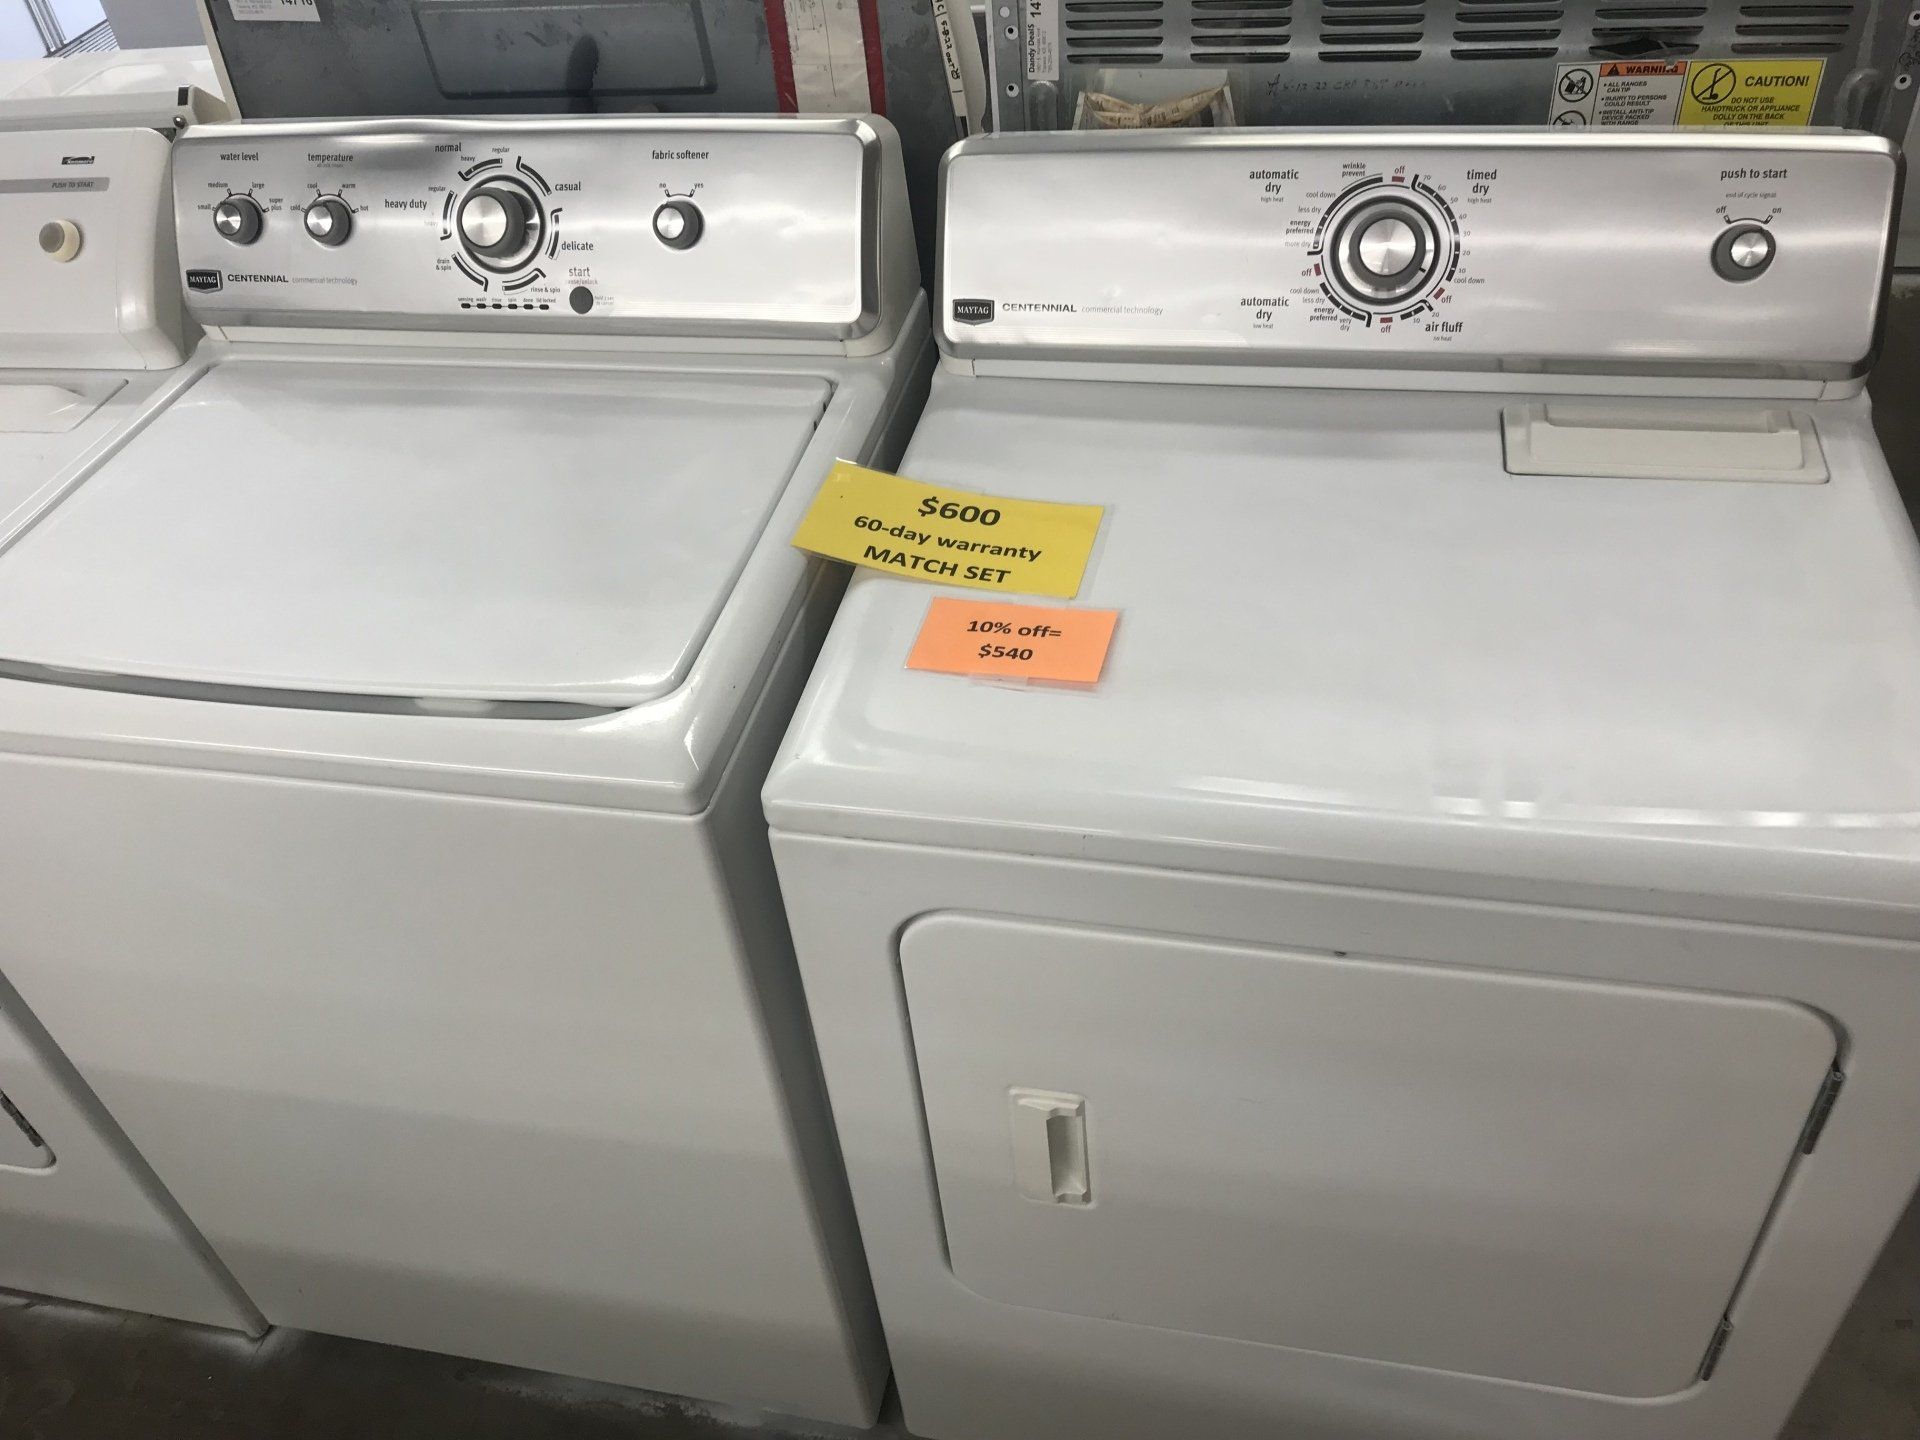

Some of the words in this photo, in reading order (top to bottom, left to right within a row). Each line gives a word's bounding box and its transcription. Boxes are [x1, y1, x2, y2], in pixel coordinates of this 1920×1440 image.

[1030, 0, 1042, 18] 14
[1028, 48, 1037, 73] Dandy
[1744, 75, 1810, 87] CAUTION!
[434, 142, 462, 152] normal
[220, 152, 241, 162] water
[241, 151, 259, 162] level
[307, 152, 354, 164] temperature
[460, 155, 475, 163] heavy
[652, 149, 675, 160] fabric
[676, 149, 710, 160] softener
[1342, 162, 1367, 170] wrinkle
[1394, 165, 1406, 175] off
[1249, 168, 1299, 180] automatic
[1341, 170, 1366, 178] prevent
[1466, 168, 1498, 180] timed
[1720, 167, 1747, 181] push
[1749, 168, 1760, 179] to
[1762, 168, 1788, 179] start
[251, 181, 265, 190] large
[554, 181, 582, 192] casual
[693, 182, 704, 190] yes
[1265, 181, 1282, 195] dry
[1472, 182, 1490, 196] dry
[1305, 191, 1319, 199] cool
[1319, 191, 1336, 199] down
[384, 199, 407, 211] heavy
[409, 199, 428, 211] duty
[1311, 206, 1322, 214] dry
[1715, 205, 1727, 214] off
[1289, 219, 1312, 228] energy
[1285, 227, 1314, 235] preferred
[561, 240, 594, 251] delicate
[1301, 240, 1311, 248] dry
[440, 264, 452, 272] spin
[568, 267, 591, 278] start
[1301, 268, 1313, 277] off
[189, 276, 217, 284] MAYTAG
[227, 274, 289, 283] CENTENNIAL
[549, 286, 561, 294] spin
[1289, 287, 1302, 295] cool
[1303, 287, 1320, 295] down
[1240, 296, 1290, 307] automatic
[1314, 296, 1326, 305] dry
[1441, 295, 1453, 304] off
[957, 305, 989, 316] MAYTAG
[1002, 303, 1078, 313] CENTENNIAL
[1081, 305, 1123, 315] commercial
[1123, 305, 1164, 316] technology
[1313, 307, 1335, 315] energy
[1256, 309, 1273, 322] dry
[1309, 314, 1338, 322] preferred
[1339, 317, 1352, 325] very
[1339, 324, 1351, 332] dry
[1380, 324, 1392, 333] off
[1425, 322, 1440, 333] air
[1441, 321, 1464, 333] fluff
[917, 496, 1001, 527] $600
[854, 515, 932, 546] 60-day
[937, 536, 1042, 563] warranty
[863, 545, 959, 577] MATCH
[963, 566, 1012, 584] SET
[966, 620, 1012, 635] 10%
[1018, 624, 1062, 638] off=
[978, 643, 1033, 661] $540
